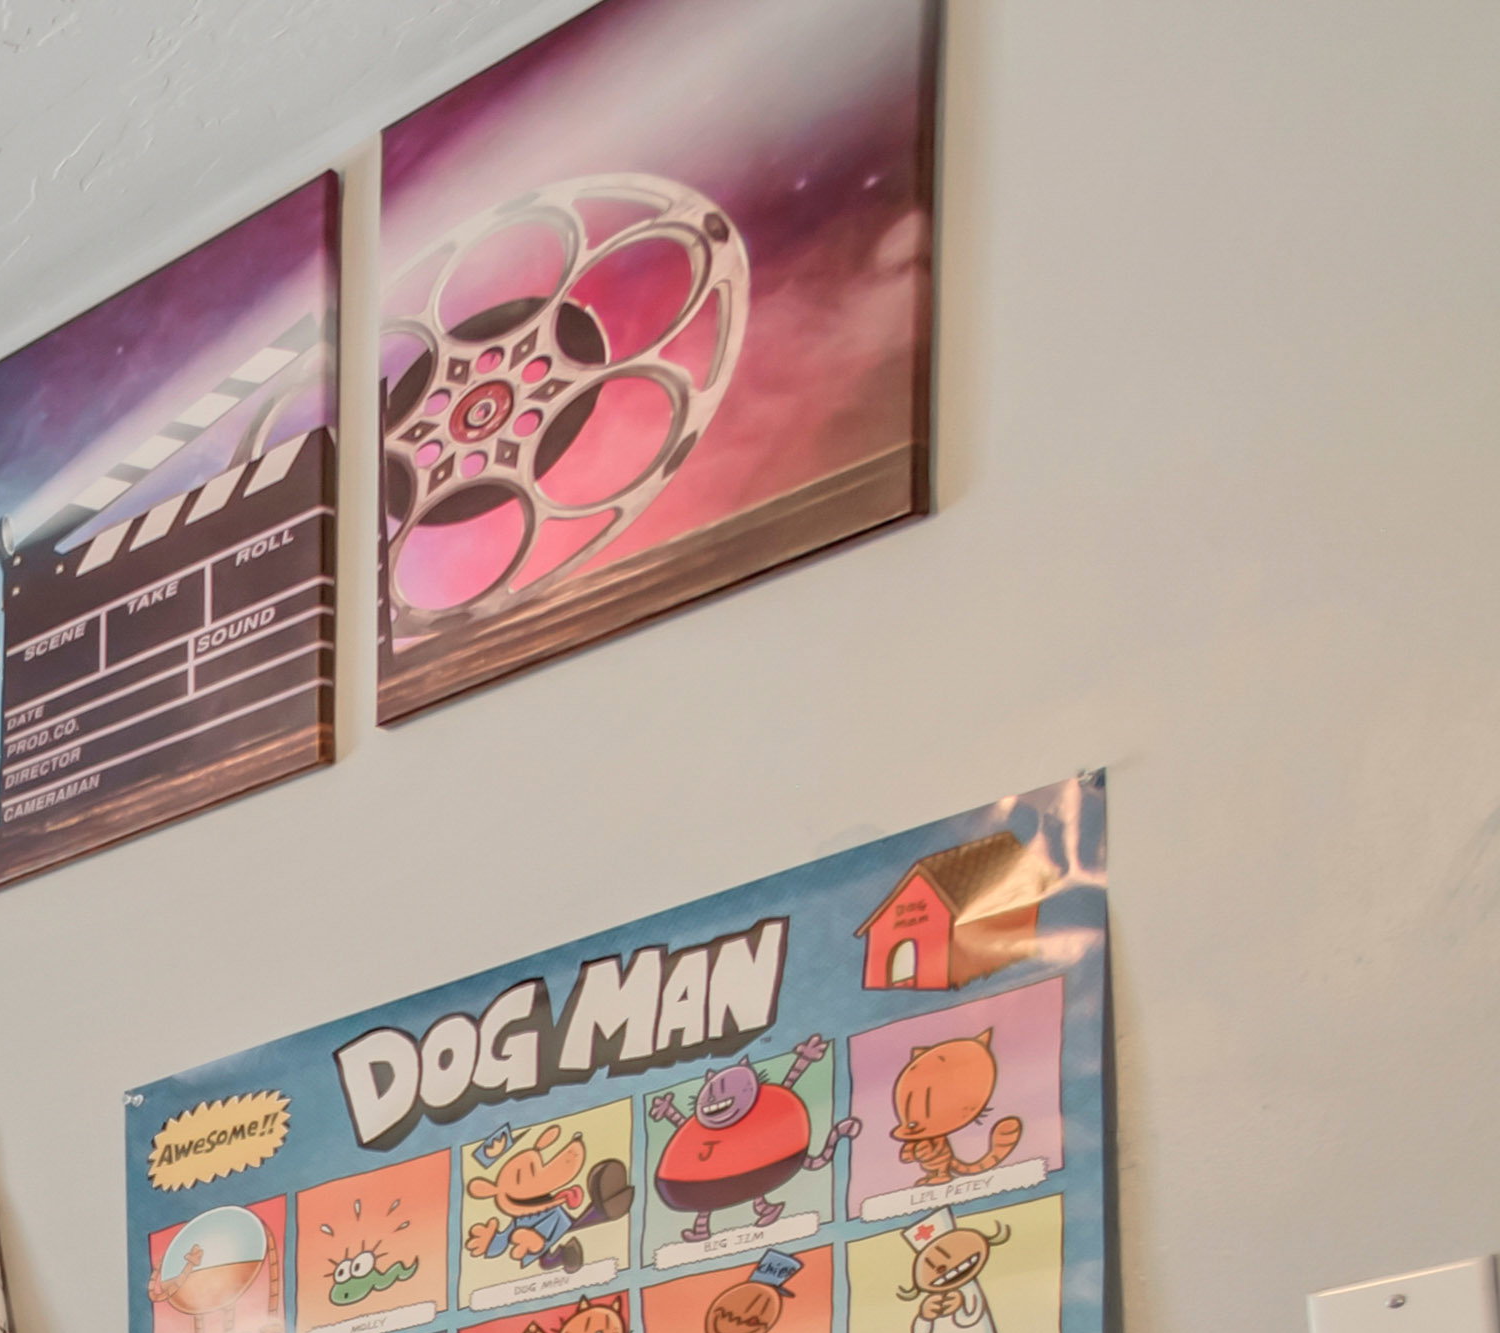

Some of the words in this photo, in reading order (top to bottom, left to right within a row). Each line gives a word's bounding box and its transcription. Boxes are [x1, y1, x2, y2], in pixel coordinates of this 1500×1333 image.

[235, 529, 294, 567] ROLL
[127, 580, 179, 615] TAKE
[24, 621, 86, 661] SCENE
[196, 607, 276, 653] SOUND
[7, 706, 45, 730] DATE
[5, 747, 81, 789] DIRECTOR
[3, 775, 100, 822] CAMERAMAN
[333, 977, 546, 1148] DOG
[558, 916, 790, 1076] MAN
[945, 1175, 995, 1197] PETEY
[704, 1238, 727, 1252] BIG
[514, 1280, 536, 1296] DOG
[541, 1276, 570, 1292] MAN
